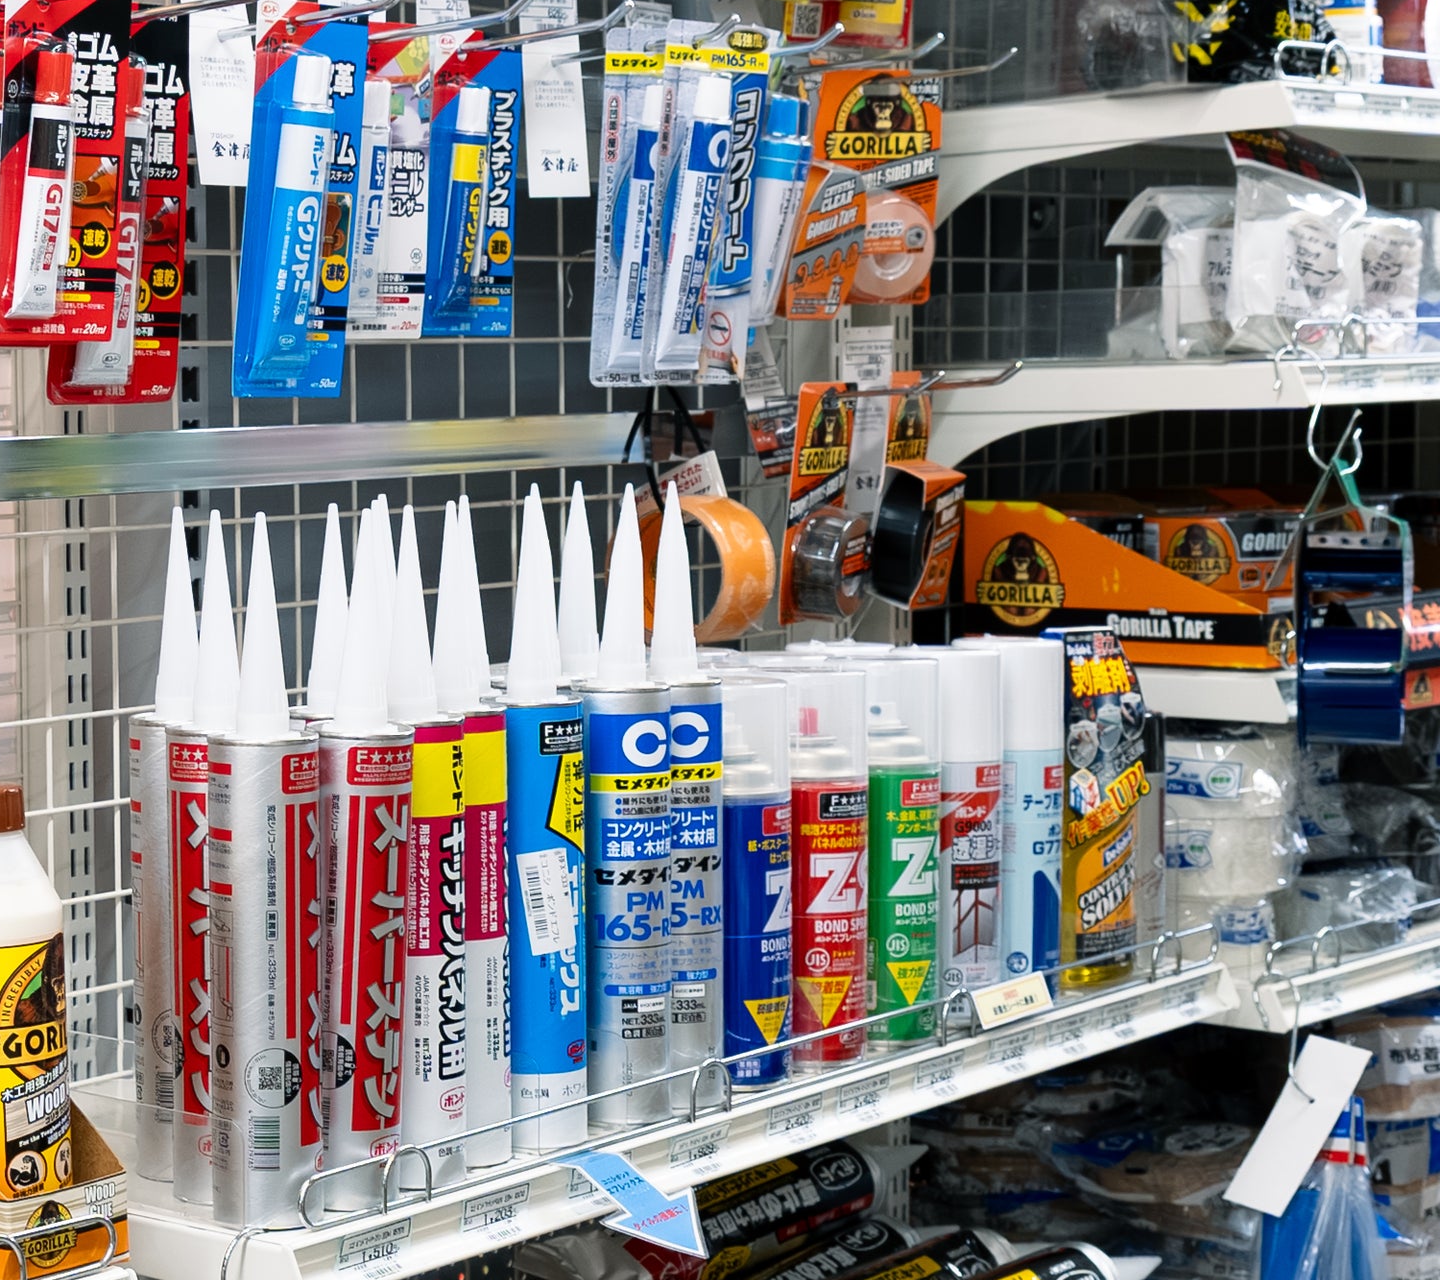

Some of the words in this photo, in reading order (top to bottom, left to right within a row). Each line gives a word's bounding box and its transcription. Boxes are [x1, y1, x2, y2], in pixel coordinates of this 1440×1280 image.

[840, 131, 918, 156] GORILLA
[486, 91, 514, 229] プラスチック用
[985, 585, 1056, 608] GORILLA
[1106, 612, 1167, 638] GORILLA
[1170, 618, 1215, 640] TAPE
